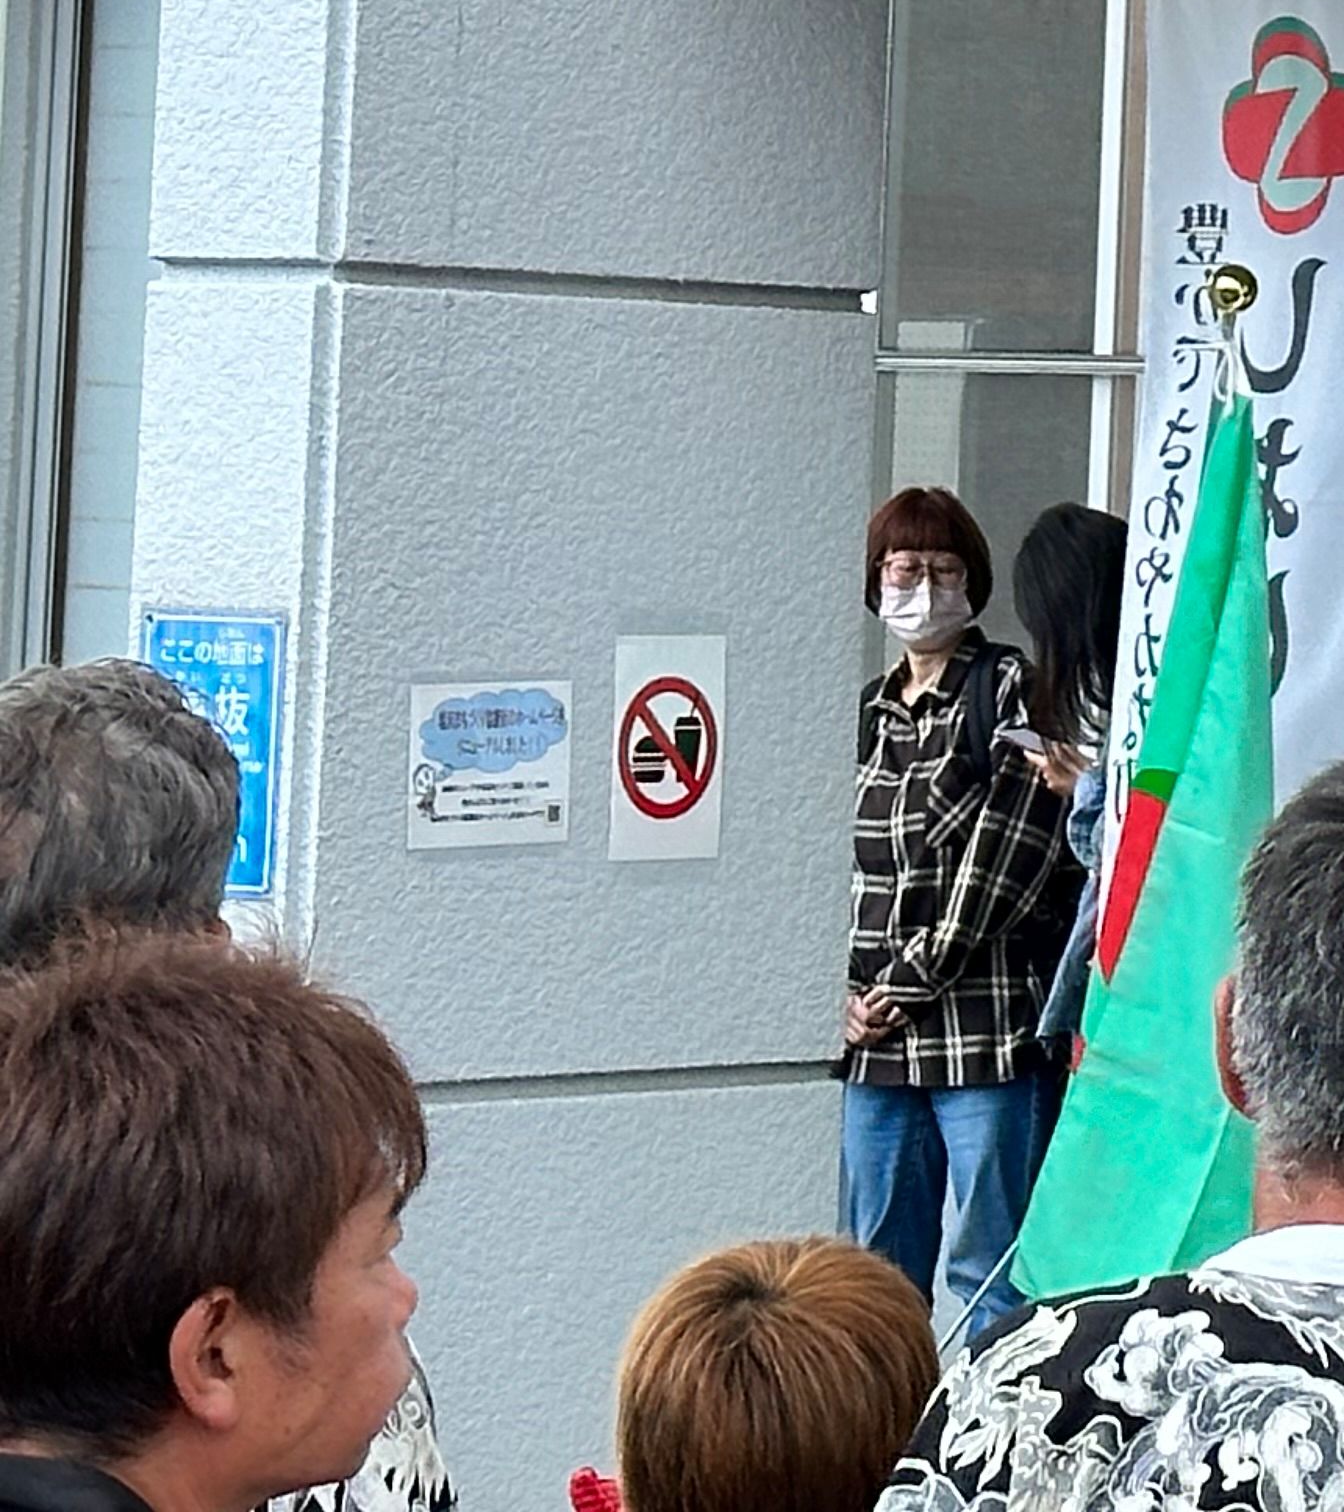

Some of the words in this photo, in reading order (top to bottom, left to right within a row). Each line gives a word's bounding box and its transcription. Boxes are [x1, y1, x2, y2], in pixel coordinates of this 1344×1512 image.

[160, 639, 265, 666] ここの地面は
